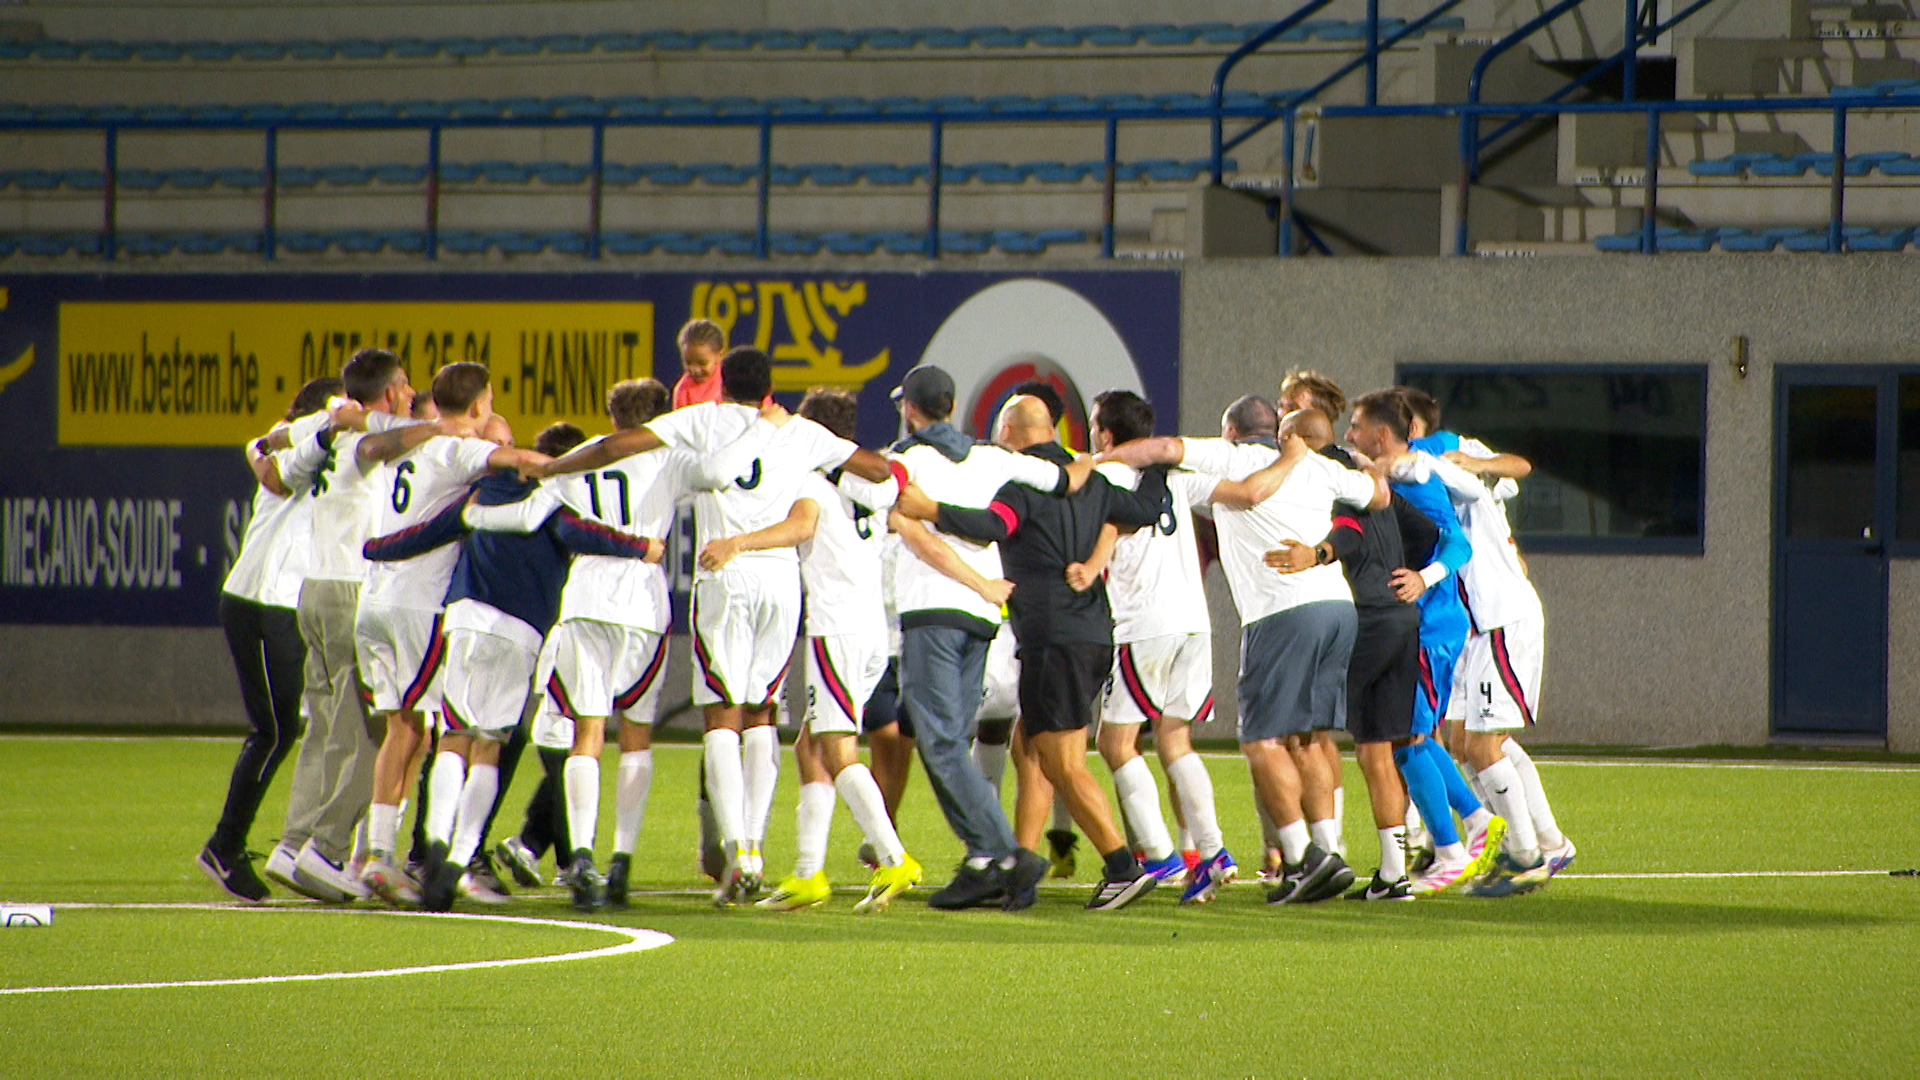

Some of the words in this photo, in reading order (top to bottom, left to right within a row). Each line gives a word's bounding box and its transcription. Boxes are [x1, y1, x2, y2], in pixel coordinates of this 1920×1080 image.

[69, 330, 259, 415] www.betam.be
[520, 330, 639, 416] HANNUT
[392, 460, 415, 514] 6
[585, 469, 631, 526] 17
[3, 498, 183, 587] MECANO-SOUDE
[1480, 681, 1492, 705] 4
